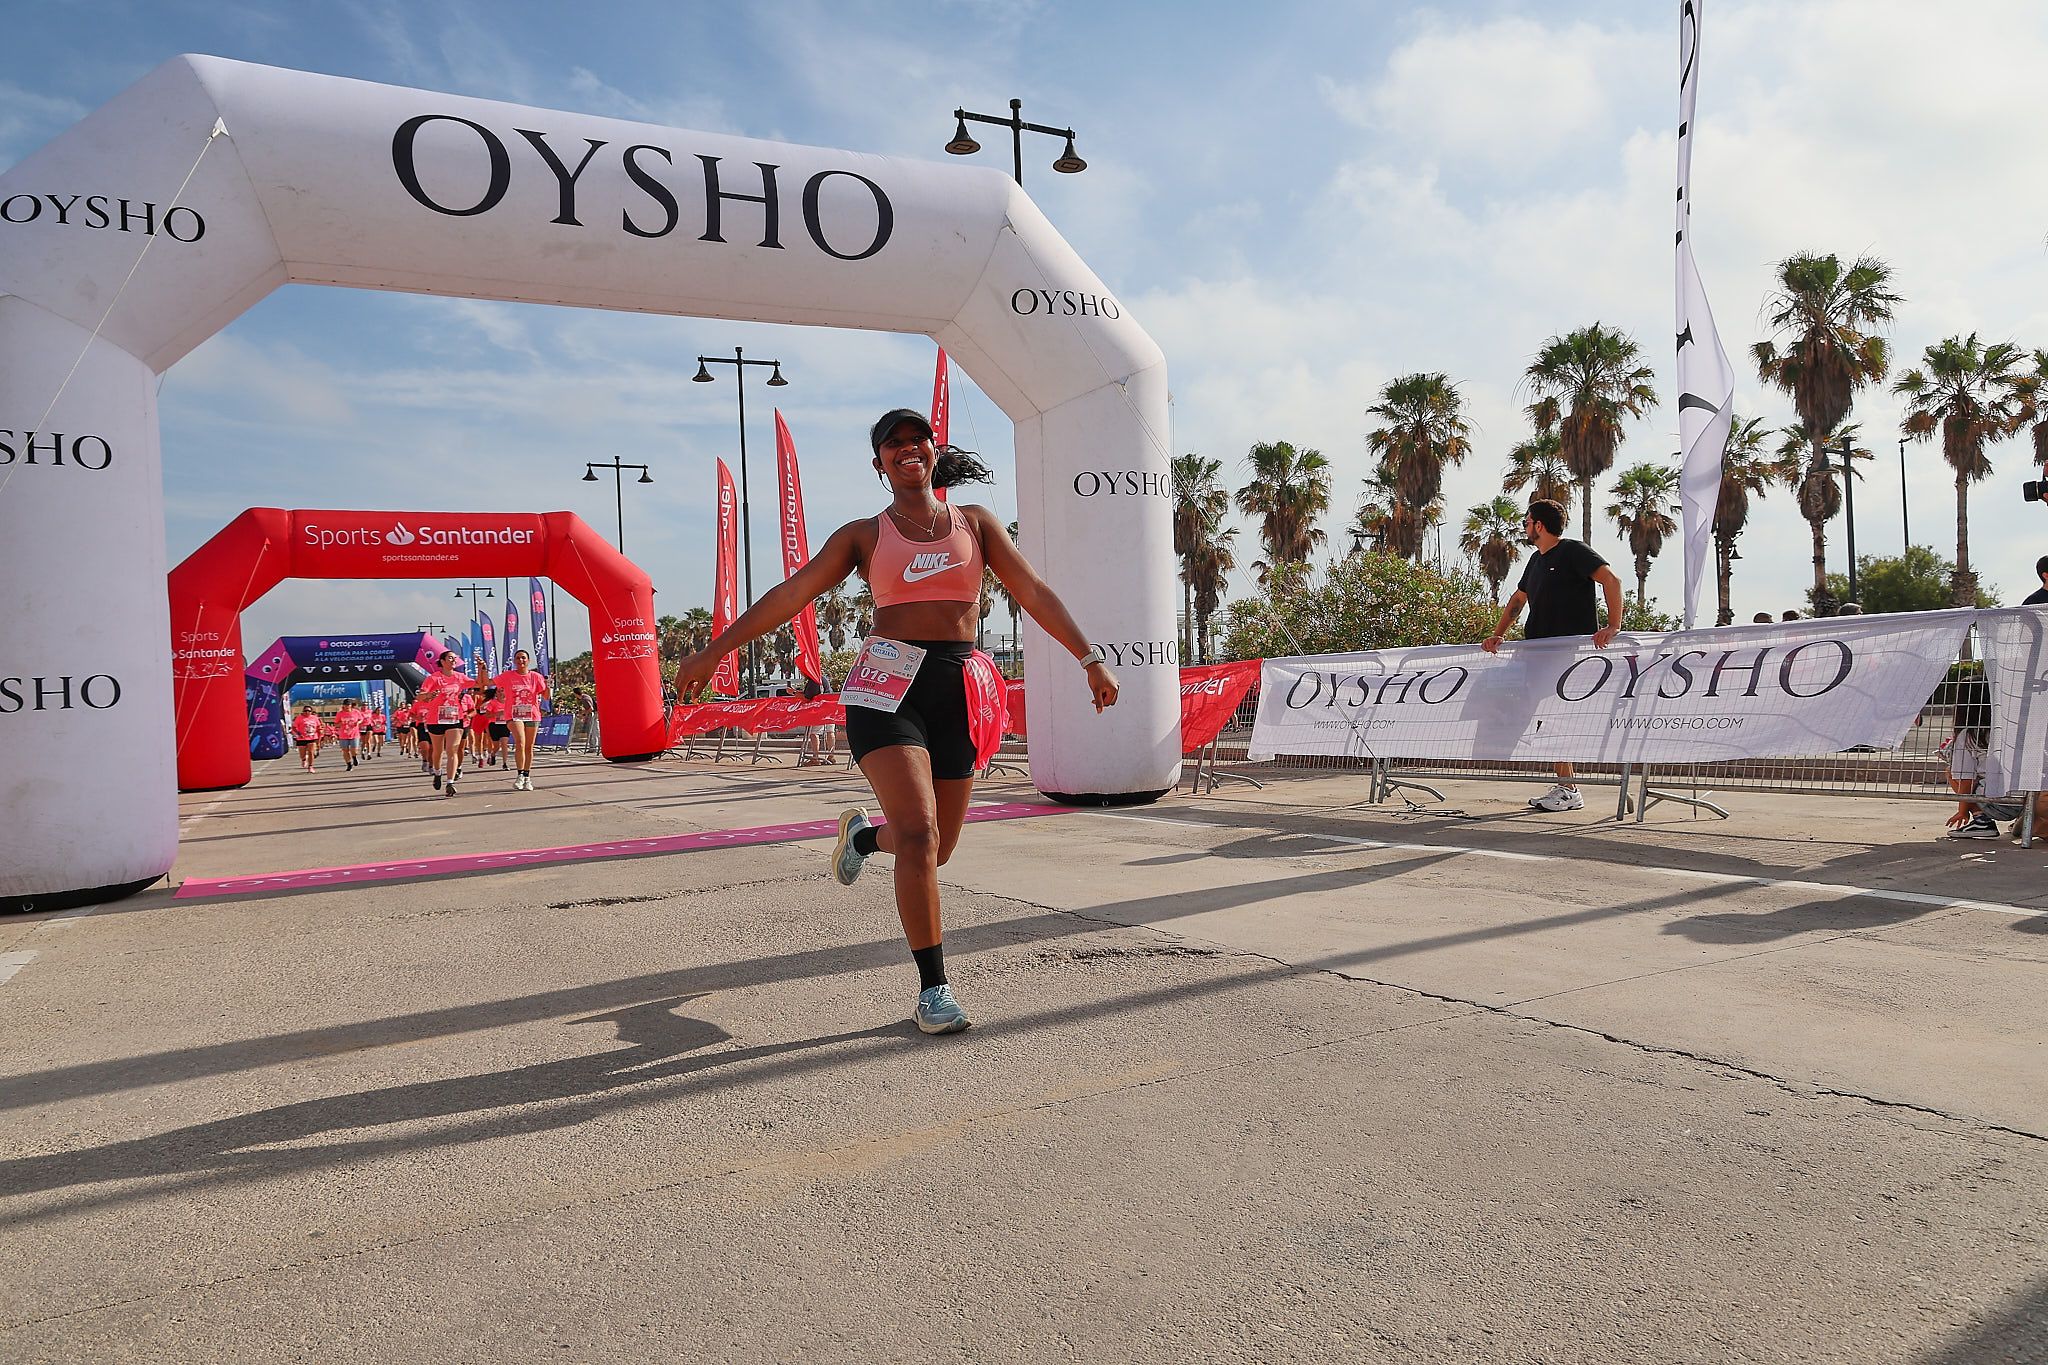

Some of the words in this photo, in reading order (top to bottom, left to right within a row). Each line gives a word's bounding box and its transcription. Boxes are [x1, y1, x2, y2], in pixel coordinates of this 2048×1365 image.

[391, 114, 894, 261] OYSHO
[0, 194, 206, 243] OYSHO
[1011, 288, 1120, 320] OYSHO
[0, 429, 112, 471] SHO
[1073, 470, 1171, 499] OYSHO
[304, 525, 381, 550] Sports
[418, 526, 534, 545] Santander
[382, 553, 459, 562] sportssantander.es
[912, 552, 950, 569] NIKE
[614, 617, 644, 628] Sports
[180, 631, 219, 643] Sports
[613, 632, 655, 642] Santander
[178, 647, 236, 659] Santander
[303, 663, 383, 673] VOLVO
[860, 667, 890, 683] 016
[1555, 639, 1854, 702] OYSHO
[0, 674, 121, 713] SHO
[1285, 666, 1470, 709] OYSHO
[1609, 717, 1744, 730] WWW.OYSHO.COM
